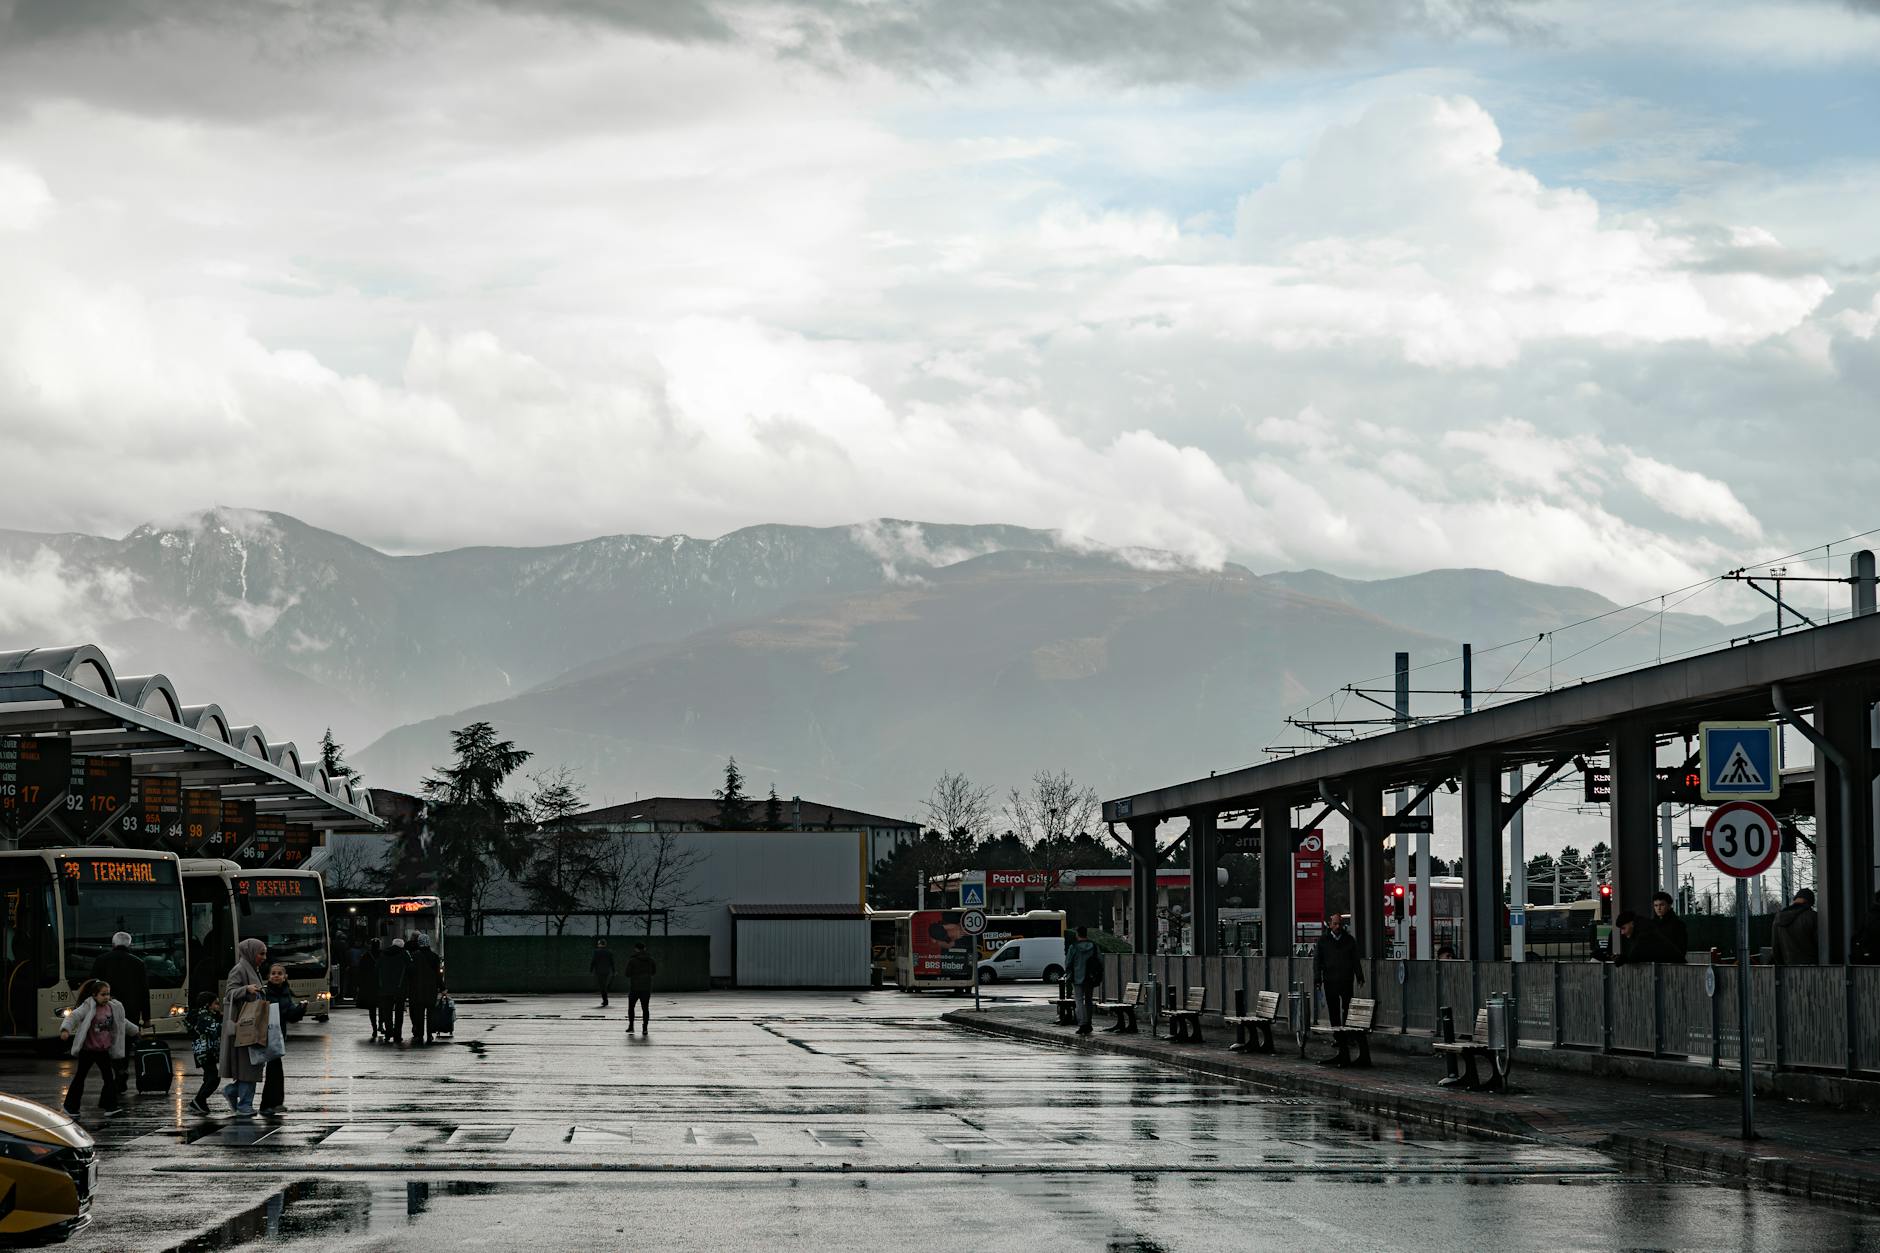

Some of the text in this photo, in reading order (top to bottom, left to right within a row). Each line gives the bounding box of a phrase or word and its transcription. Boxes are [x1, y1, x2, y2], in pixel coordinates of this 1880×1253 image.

[0, 785, 16, 796] 1G
[20, 785, 40, 803] 17
[66, 794, 84, 811] 92
[89, 794, 116, 812] 17C
[122, 816, 138, 831] 93
[169, 824, 183, 837] 94
[188, 823, 203, 838] 98
[225, 831, 238, 845] F1
[1719, 823, 1765, 858] 30
[243, 847, 256, 859] 96
[91, 861, 157, 882] TERMINAL
[992, 873, 1025, 884] Petrol
[389, 903, 401, 914] 97
[966, 916, 982, 927] 30
[924, 961, 965, 970] BRS Haber
